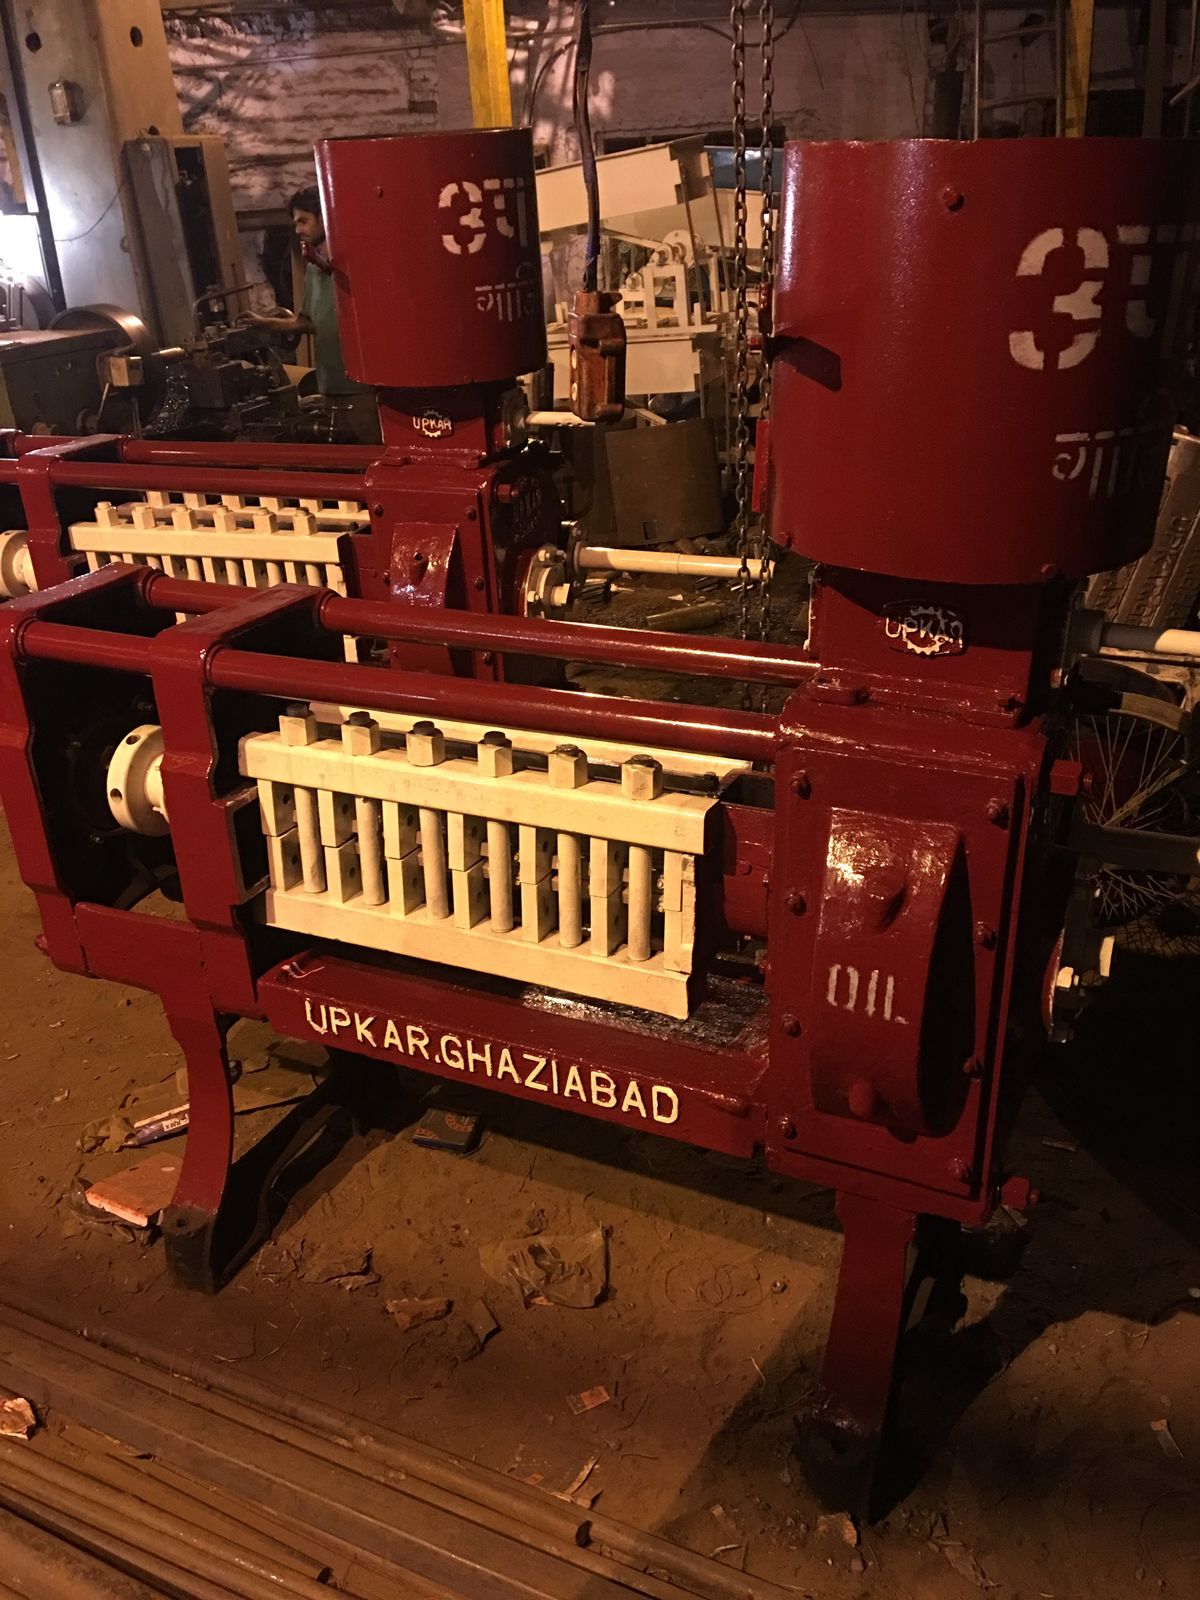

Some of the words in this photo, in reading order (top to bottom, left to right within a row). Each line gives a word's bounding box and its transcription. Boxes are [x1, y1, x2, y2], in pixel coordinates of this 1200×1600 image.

[412, 416, 453, 431] UPKAR
[885, 615, 964, 650] UPKAR
[826, 963, 910, 1025] OIL
